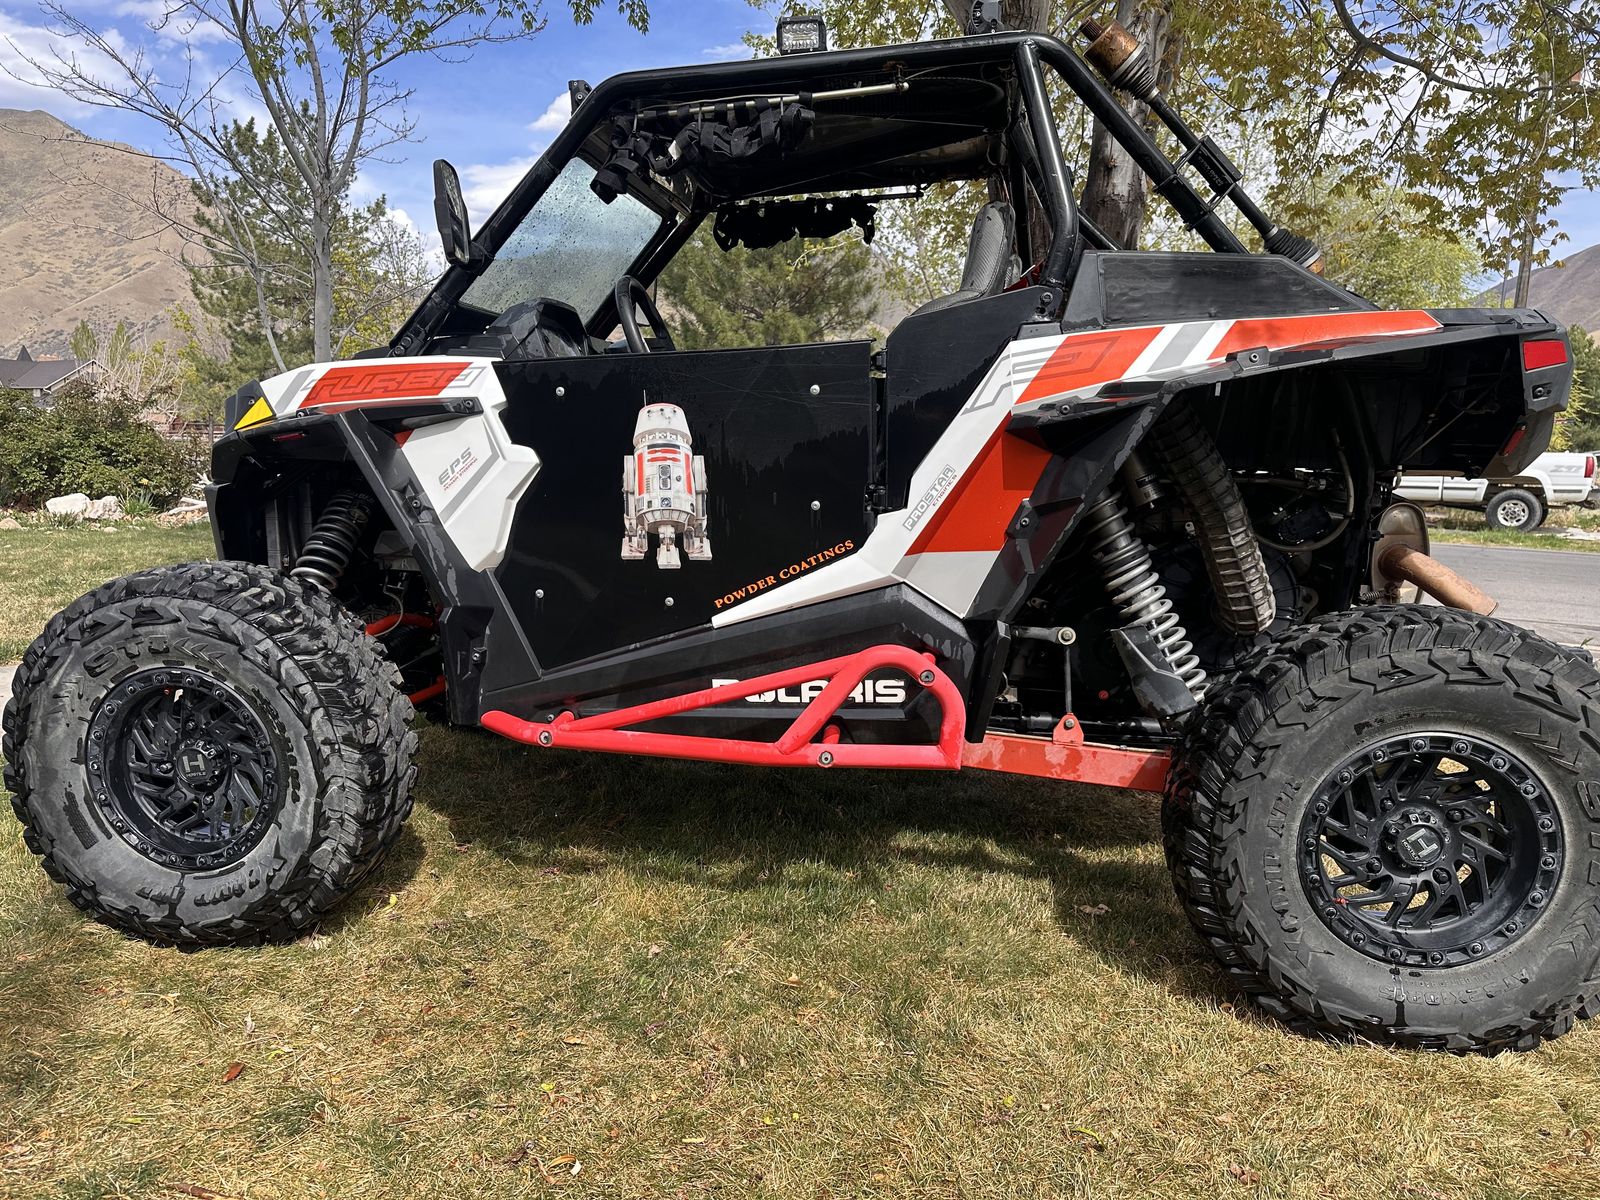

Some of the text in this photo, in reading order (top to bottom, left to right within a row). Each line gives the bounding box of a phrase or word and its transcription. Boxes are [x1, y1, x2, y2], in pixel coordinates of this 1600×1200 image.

[302, 366, 486, 401] TURBO
[438, 446, 472, 485] EPS
[903, 465, 955, 530] PROSTAR
[713, 539, 855, 609] POWDER COATINGS
[711, 678, 906, 704] LAIS
